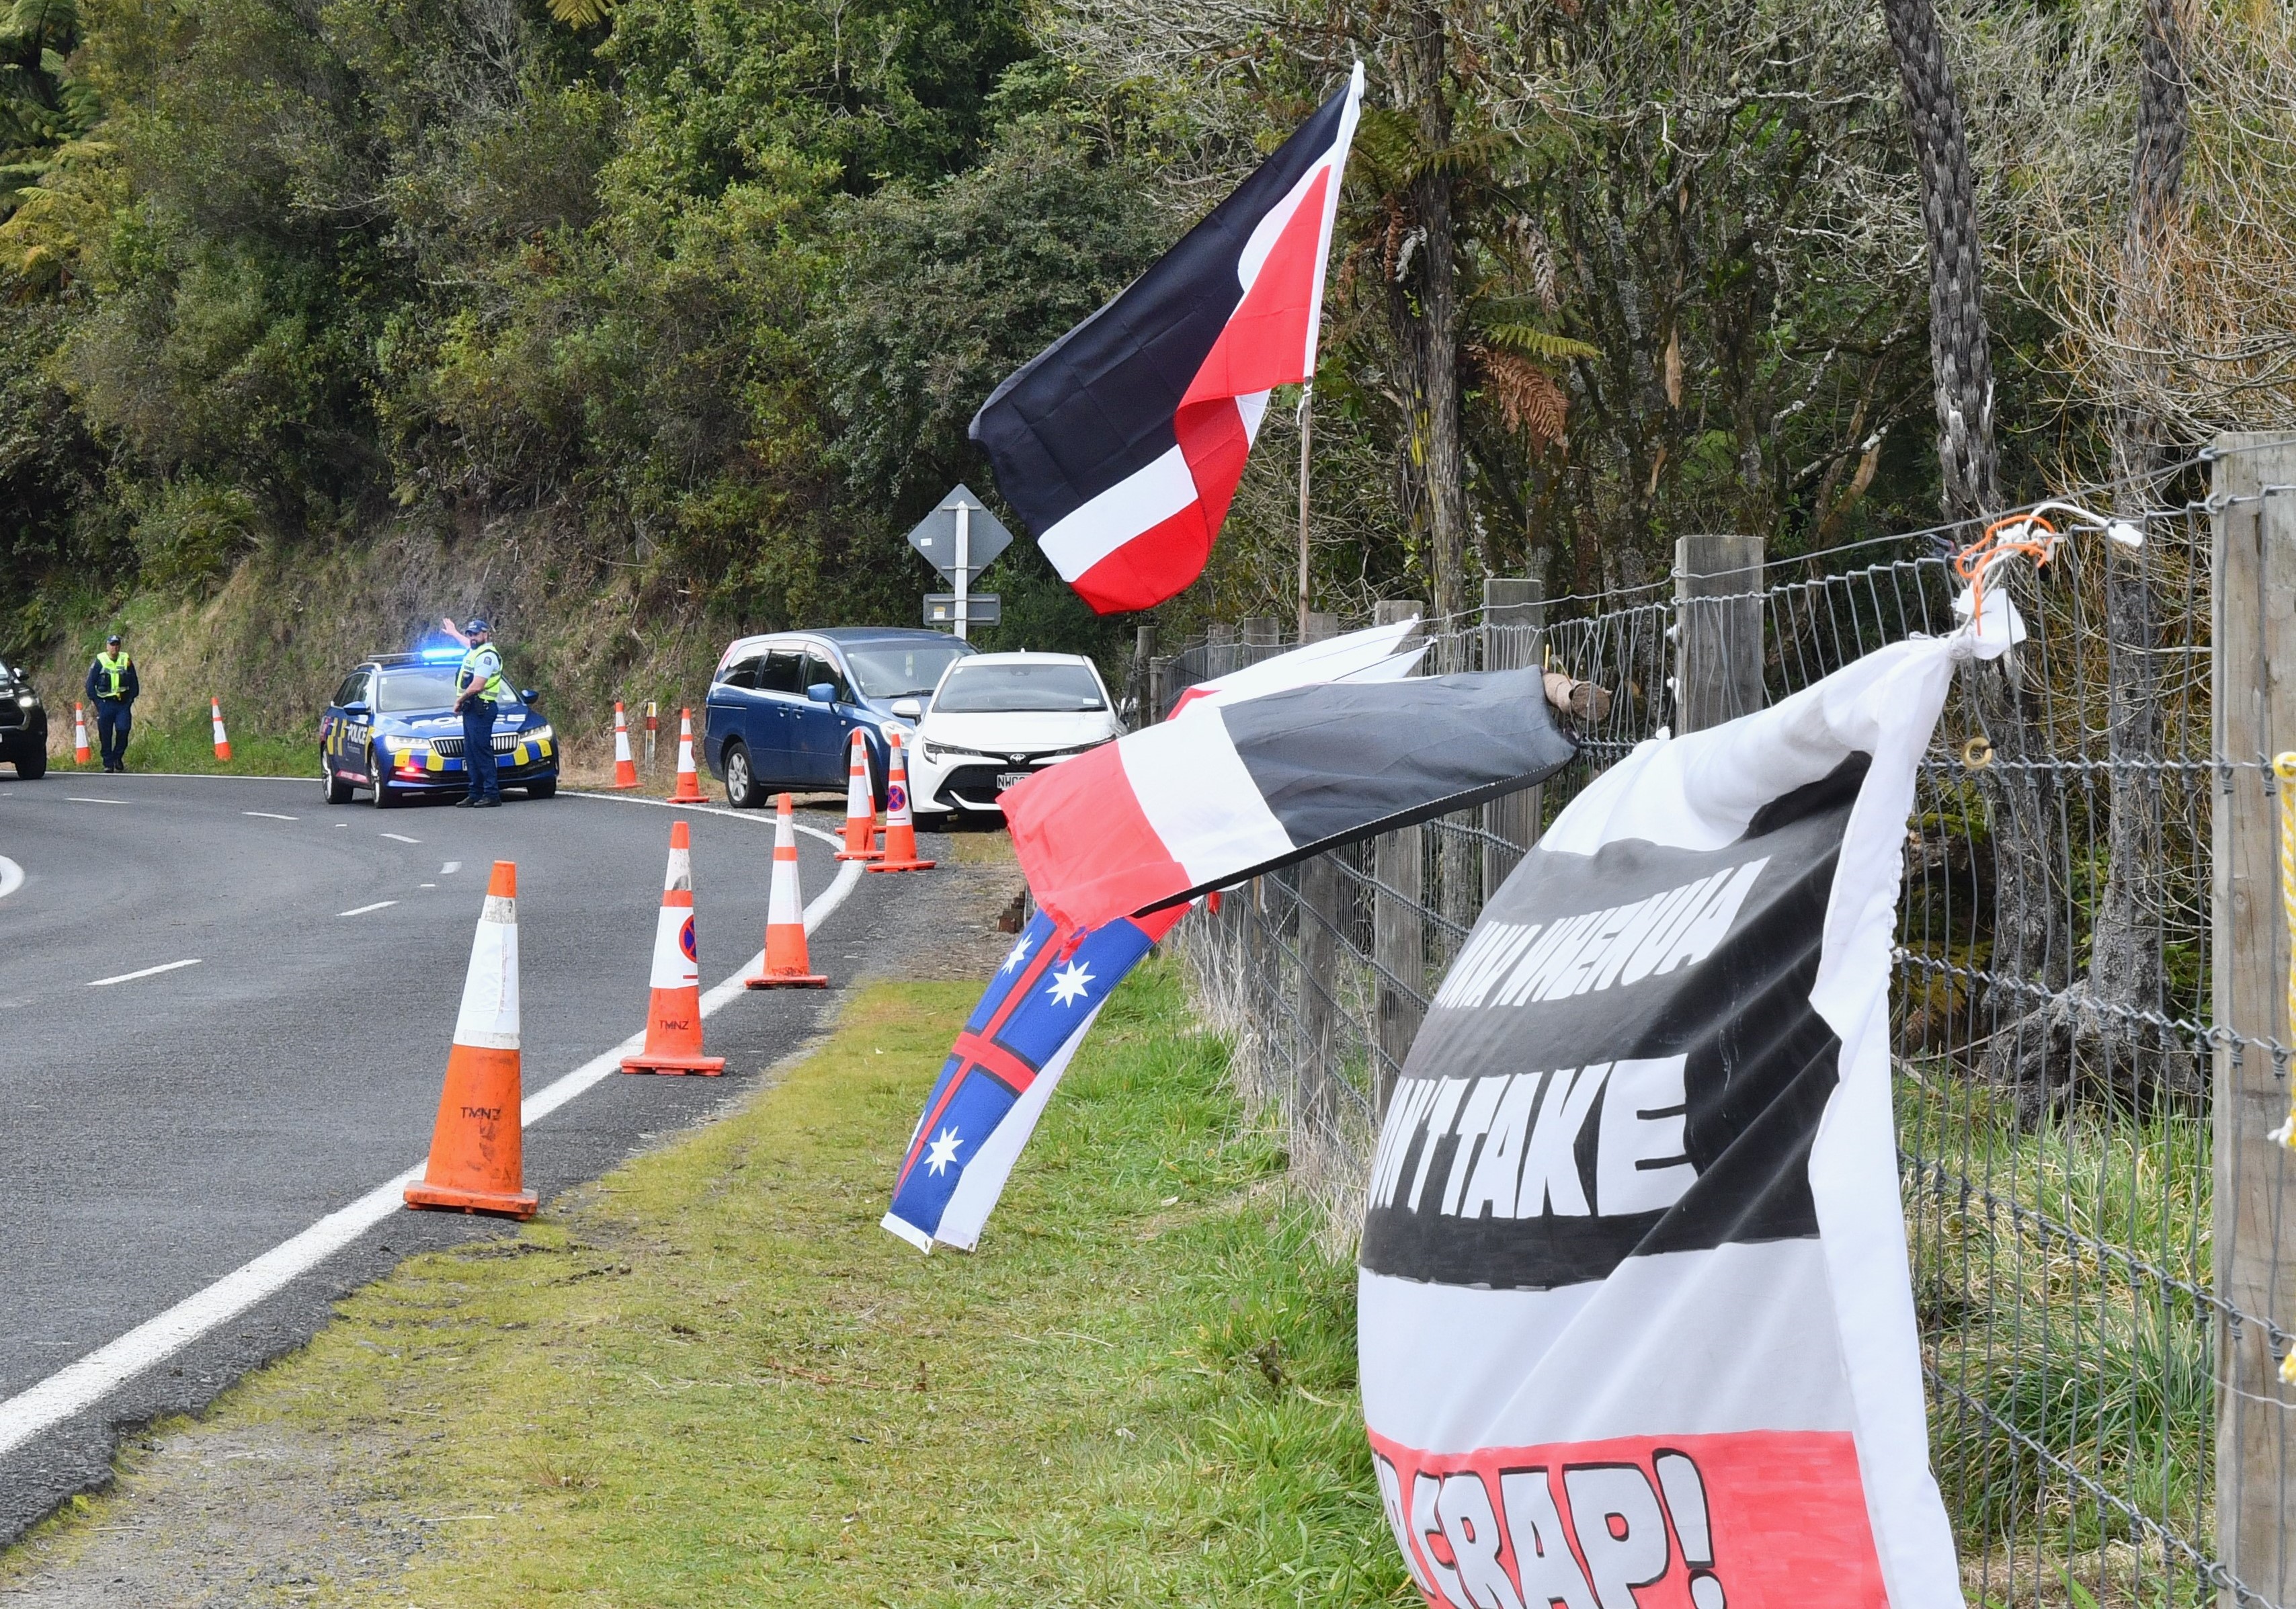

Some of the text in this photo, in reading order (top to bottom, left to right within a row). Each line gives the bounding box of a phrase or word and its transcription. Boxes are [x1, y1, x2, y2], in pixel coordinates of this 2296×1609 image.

[411, 714, 526, 730] POCE
[347, 723, 368, 745] POLICE
[1488, 856, 1772, 1009] WHENUA
[659, 1020, 689, 1030] TMNZ
[460, 1106, 501, 1121] TMNZ
[1369, 1053, 1699, 1220] ON'T TAKE
[1411, 1447, 1727, 1609] CRAP!
